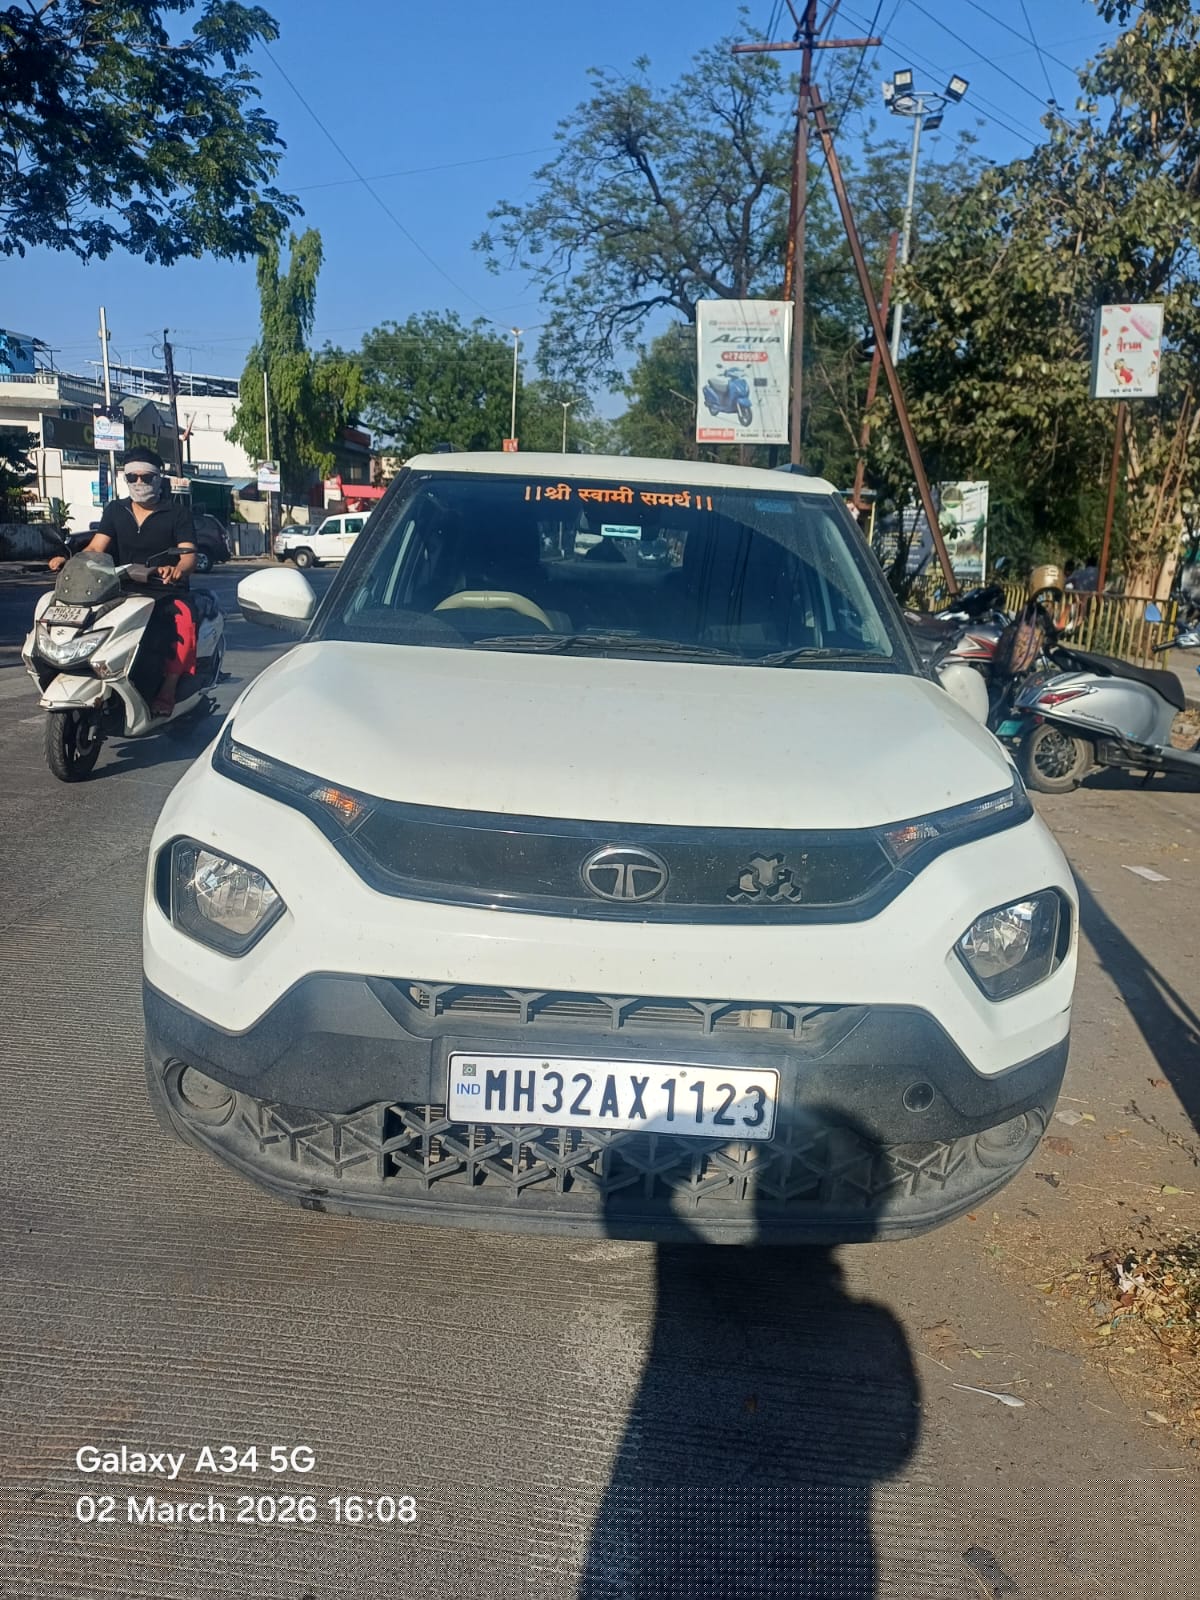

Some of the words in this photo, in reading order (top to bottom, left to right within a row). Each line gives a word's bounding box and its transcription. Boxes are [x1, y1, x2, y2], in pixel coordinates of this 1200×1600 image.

[577, 486, 634, 505] स्वामी
[456, 1083, 481, 1096] IND
[484, 1069, 768, 1127] MH32AX1123
